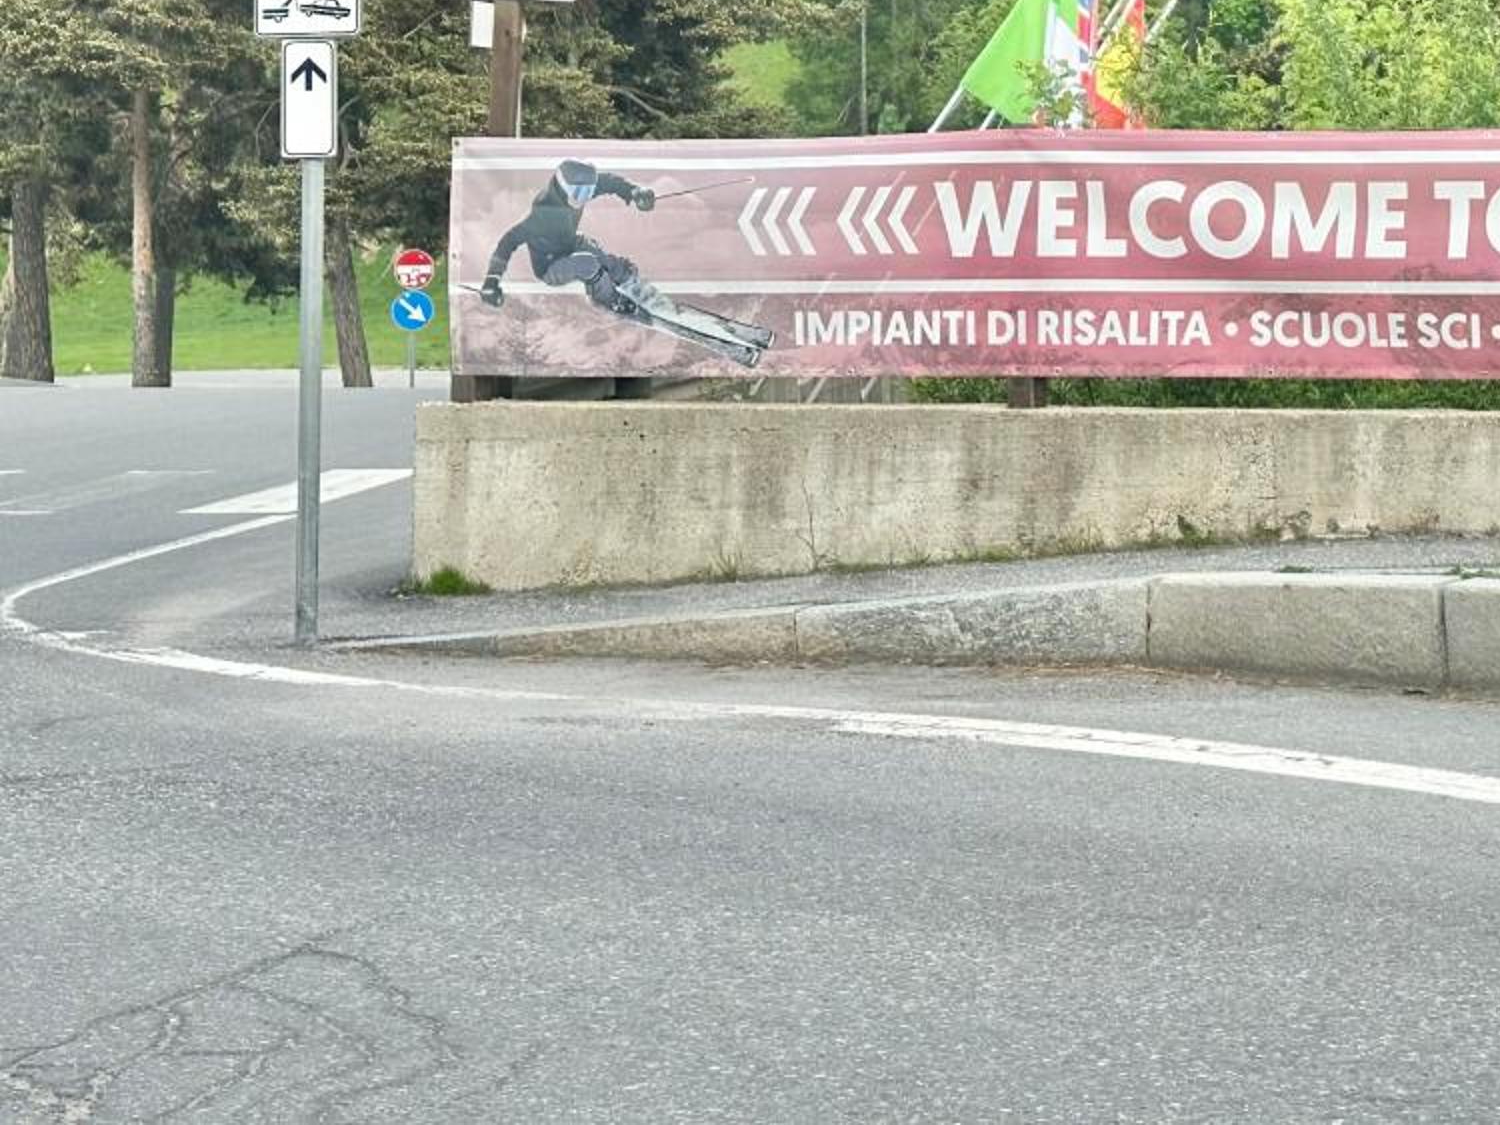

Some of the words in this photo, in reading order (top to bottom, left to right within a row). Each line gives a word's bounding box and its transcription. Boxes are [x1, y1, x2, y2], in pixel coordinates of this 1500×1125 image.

[934, 181, 1408, 258] WELCOME
[795, 311, 975, 348] IMPIANTI
[988, 311, 1026, 345] DI
[1038, 310, 1211, 345] RISALITA
[1250, 311, 1408, 347] SCUOLE
[1418, 313, 1480, 348] SCI
